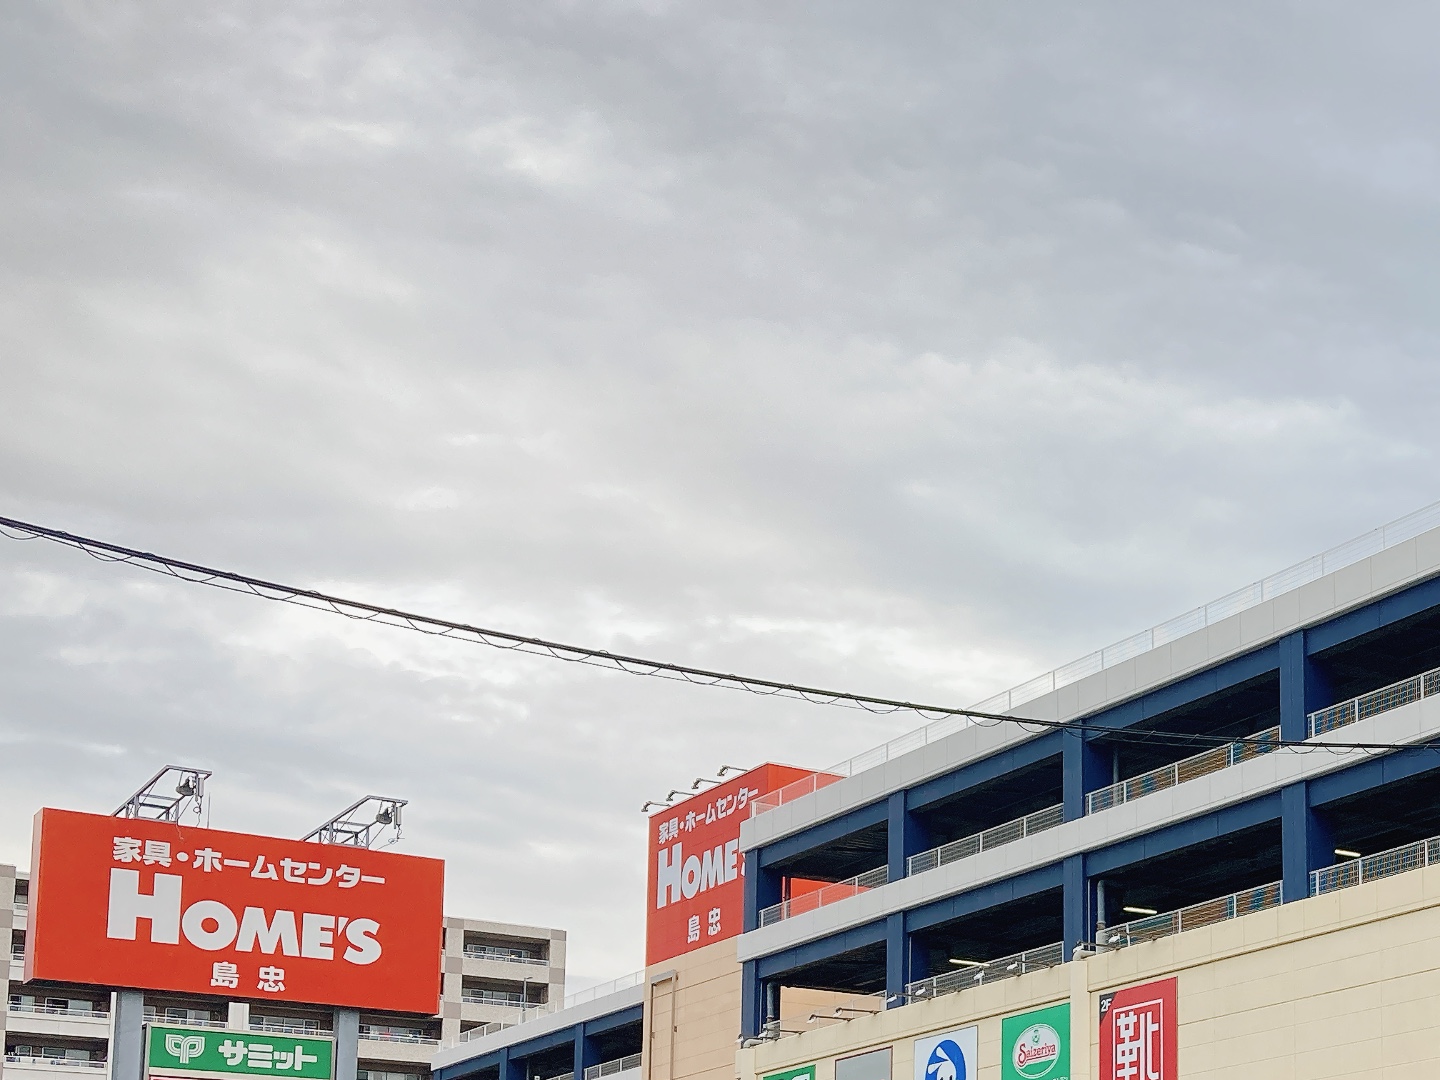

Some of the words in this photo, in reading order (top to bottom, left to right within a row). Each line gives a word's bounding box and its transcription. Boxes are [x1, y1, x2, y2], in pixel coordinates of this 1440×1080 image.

[658, 786, 758, 844] 家具・ホームセンター
[112, 836, 386, 888] 家具・ホームセンター
[656, 837, 746, 909] HOME
[106, 867, 383, 966] HOME'S
[687, 907, 721, 944] 島忠
[210, 961, 286, 992] 島忠
[1101, 999, 1112, 1012] 2F
[218, 1040, 318, 1070] サミット
[1017, 1042, 1057, 1068] Saizeriya
